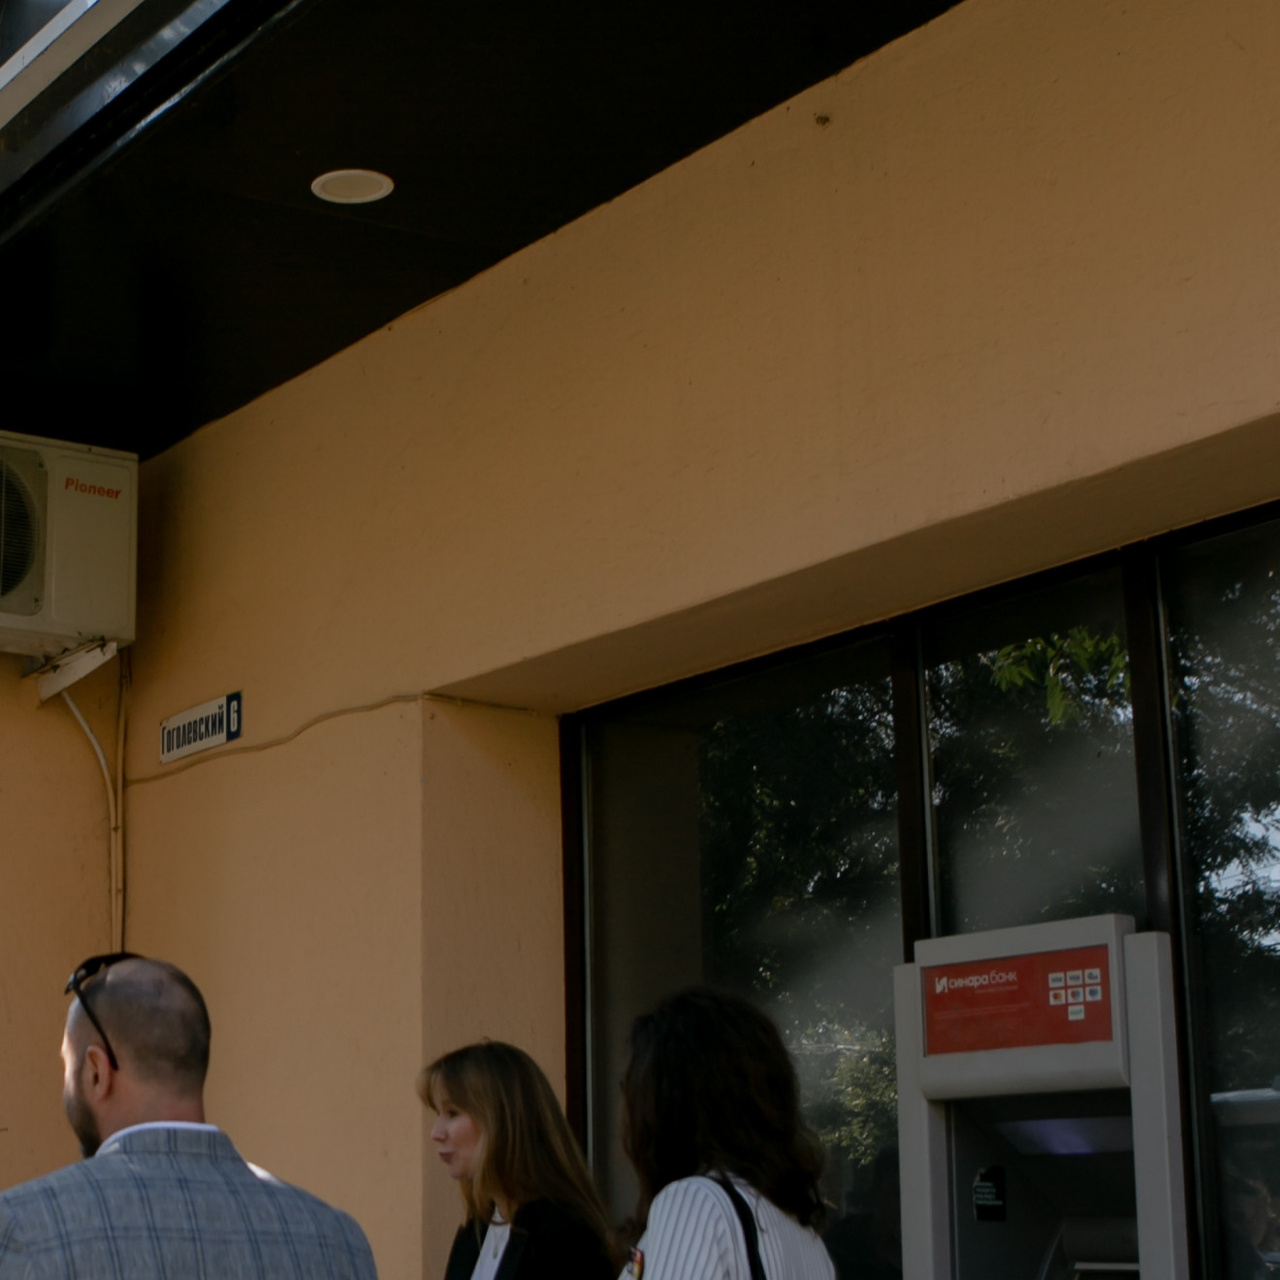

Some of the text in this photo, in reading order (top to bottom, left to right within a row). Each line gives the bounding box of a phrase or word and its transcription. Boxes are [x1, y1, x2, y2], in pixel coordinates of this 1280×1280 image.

[65, 477, 122, 499] Pioneer
[161, 700, 239, 755] Гоголевский 6
[949, 969, 1018, 989] синара банк
